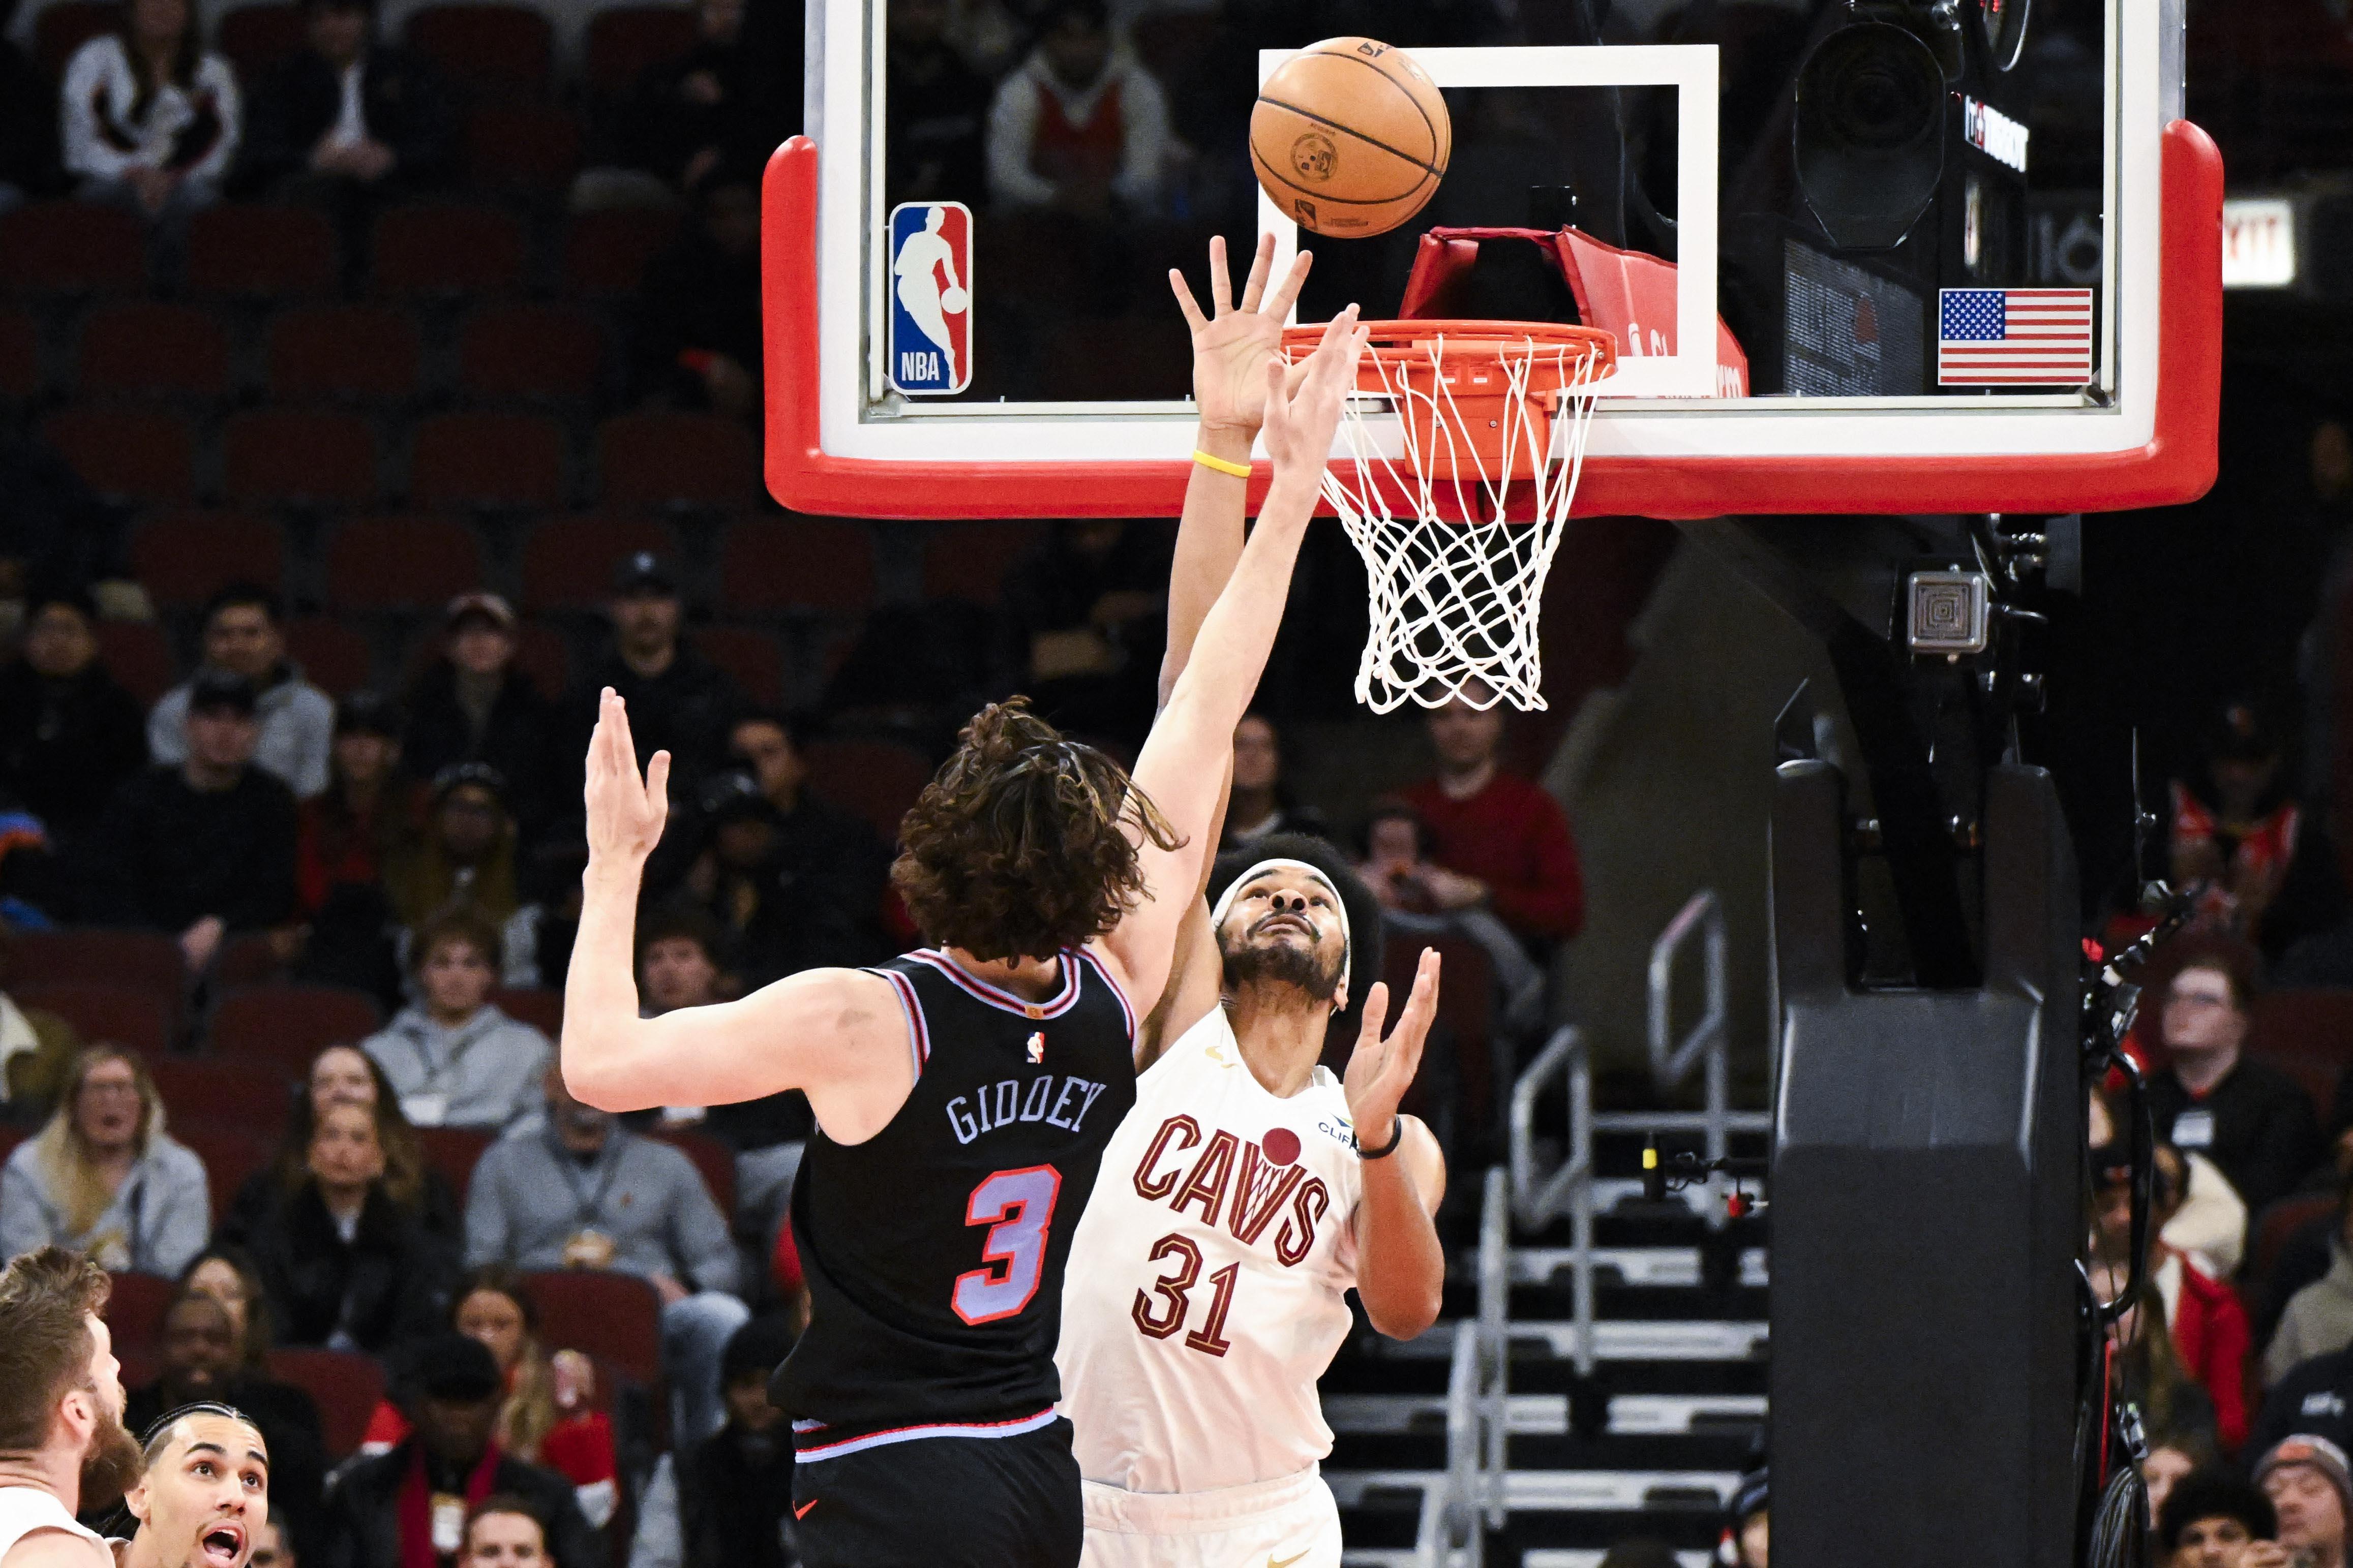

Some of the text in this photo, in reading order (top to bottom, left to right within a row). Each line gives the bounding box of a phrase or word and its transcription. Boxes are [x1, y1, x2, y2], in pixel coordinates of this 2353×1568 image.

[901, 352, 940, 381] NBA
[946, 1075, 1107, 1145] GIDDEY
[1318, 1122, 1353, 1150] CLIF
[1133, 1114, 1330, 1267] CAVS
[951, 1163, 1062, 1326] 3
[1131, 1233, 1240, 1358] 31
